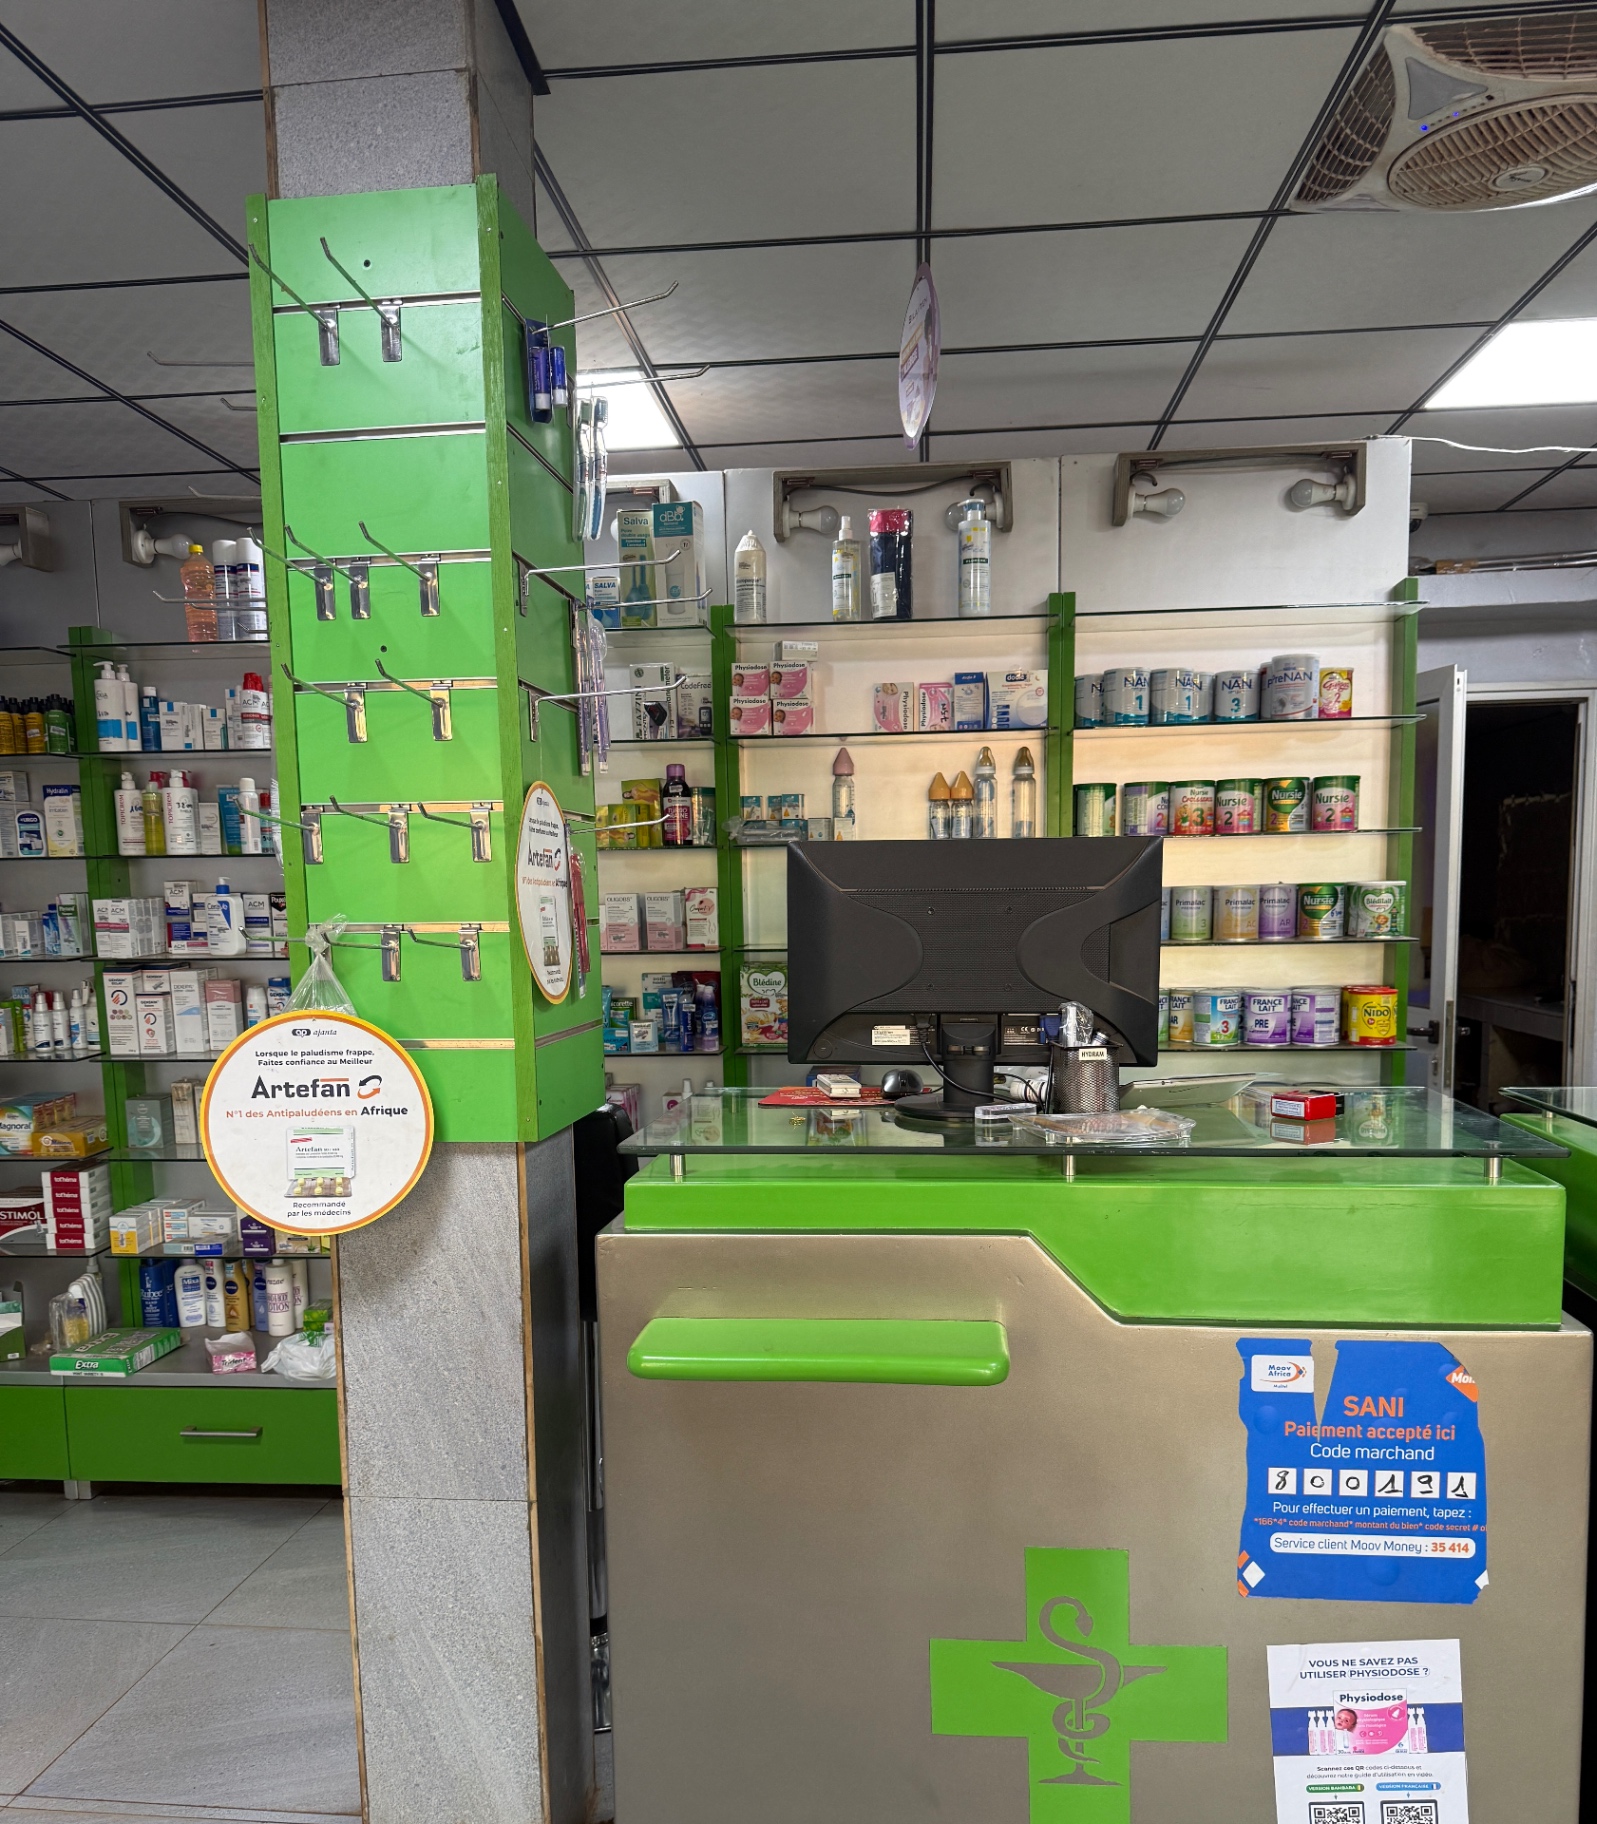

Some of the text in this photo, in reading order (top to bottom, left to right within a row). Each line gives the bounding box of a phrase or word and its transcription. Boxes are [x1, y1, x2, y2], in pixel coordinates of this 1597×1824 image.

[623, 517, 649, 526] Salva
[1272, 671, 1313, 684] PreNAN
[1221, 679, 1252, 691] NAN
[1135, 694, 1143, 711] 1
[1230, 698, 1241, 713] 3
[1272, 789, 1303, 800] Nursie
[1315, 793, 1350, 804] Nursie
[1217, 796, 1247, 807] Nursie
[1192, 807, 1205, 827] 3
[1224, 811, 1233, 826] 2
[1270, 813, 1278, 825] 2
[1325, 808, 1335, 823] 2
[1303, 896, 1334, 906] Nursie
[1200, 919, 1206, 928] 3
[753, 978, 782, 987] Blédine
[1252, 998, 1283, 1006] FRANCE
[1363, 1008, 1390, 1017] NIDO
[1221, 1020, 1230, 1034] 3
[1254, 1018, 1270, 1029] PRE
[255, 1049, 344, 1058] Lorsque le paludisme
[1081, 1051, 1105, 1059] HYDRAM
[257, 1058, 283, 1066] Faites
[285, 1058, 326, 1066] confiance
[251, 1075, 351, 1099] Artefan
[226, 1106, 408, 1119] N°1 des Antipaludéens en Afrique
[293, 1200, 346, 1209] Recommandé
[0, 1211, 42, 1220] STIMOL
[287, 1210, 300, 1218] par
[75, 1360, 99, 1369] Extra
[221, 1357, 247, 1367] Trident
[1343, 1396, 1404, 1417] SANI
[1284, 1421, 1456, 1443] Paiement accepté ici
[1310, 1443, 1435, 1460] Code marchand
[1272, 1502, 1301, 1514] Pour
[1302, 1502, 1352, 1516] effectuer
[1355, 1505, 1371, 1515] un
[1373, 1504, 1430, 1519] paiement,
[1433, 1506, 1466, 1521] tapez
[1288, 1518, 1308, 1527] code
[1354, 1521, 1388, 1530] montant
[1389, 1521, 1400, 1530] du
[1424, 1522, 1444, 1531] code
[1445, 1524, 1471, 1532] secret
[1274, 1537, 1315, 1550] Service
[1318, 1538, 1348, 1551] client
[1350, 1539, 1381, 1551] Moov
[1383, 1540, 1422, 1555] Money
[1431, 1542, 1447, 1553] 35
[1448, 1543, 1470, 1554] 414
[1309, 1656, 1419, 1668] VOUS NE SAVEZ PAS
[1299, 1667, 1429, 1679] UTILISER PHYSIODOSE ?
[1339, 1692, 1404, 1704] Physiodose
